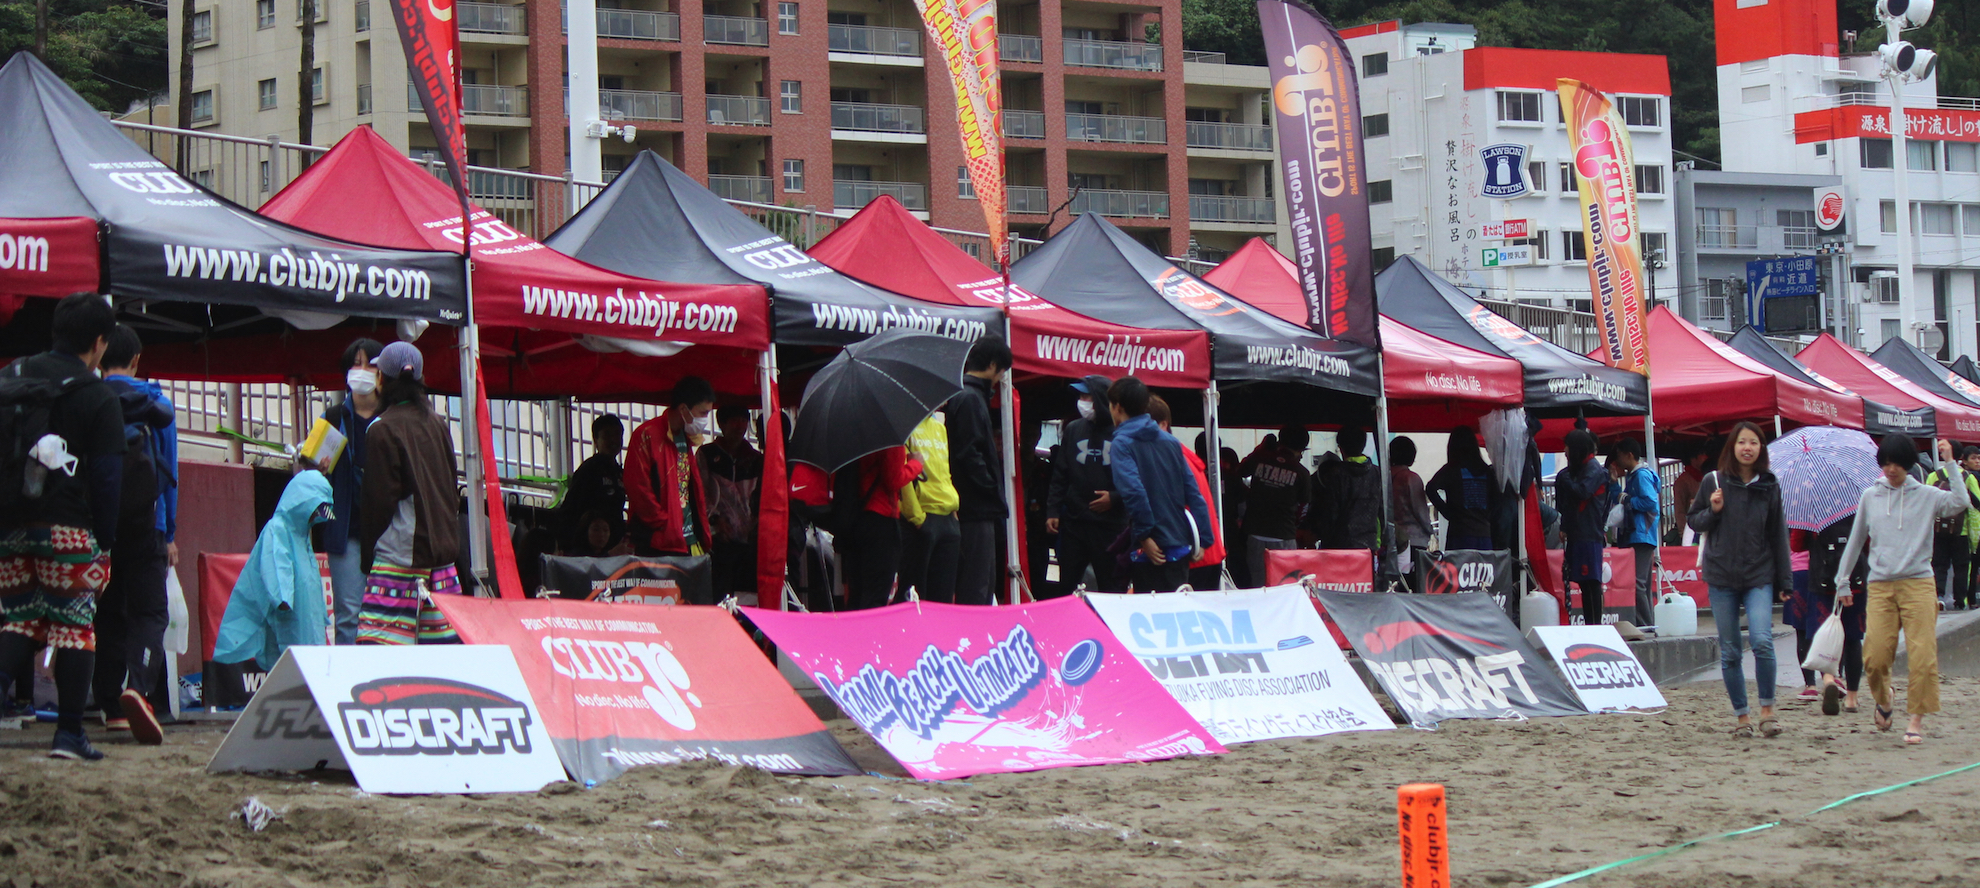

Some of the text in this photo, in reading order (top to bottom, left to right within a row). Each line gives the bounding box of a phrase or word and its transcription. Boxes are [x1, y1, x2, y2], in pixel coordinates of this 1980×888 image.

[1483, 146, 1523, 159] LAWSON
[1485, 182, 1523, 194] STATION
[164, 243, 432, 303] www.clubjr.com
[521, 284, 739, 336] www.clubjr.com
[1036, 334, 1184, 376] www.clubjr.com
[1247, 344, 1351, 377] www.clubjr.com
[1425, 370, 1438, 388] No
[1468, 376, 1482, 392] life
[1548, 373, 1626, 402] www.clubjr.com
[1254, 463, 1298, 486] ATAMI
[1459, 562, 1495, 588] CLUB
[1197, 678, 1236, 701] FLYING
[1232, 678, 1260, 697] DISC
[1259, 669, 1332, 696] ASSOCIATION
[1566, 659, 1643, 686] DISCRAFT
[342, 706, 528, 750] DISCRAFT
